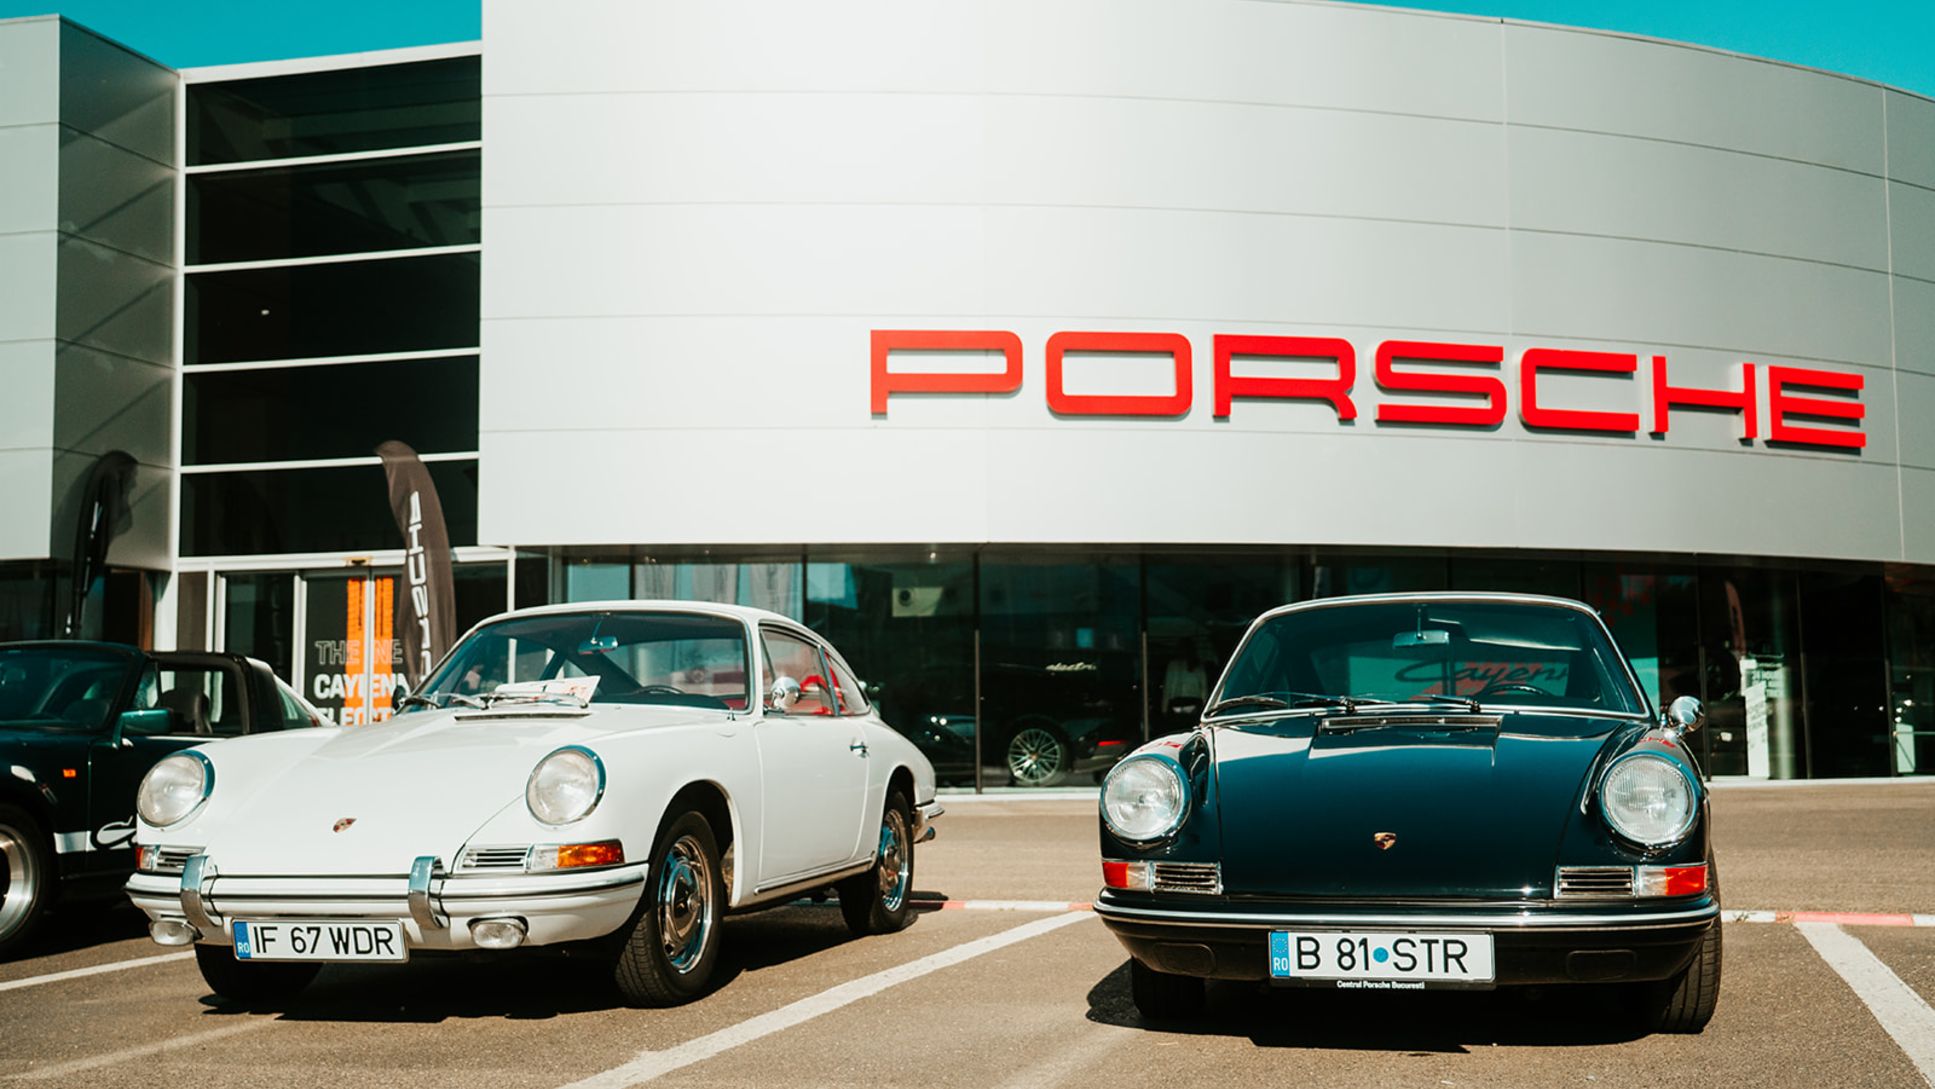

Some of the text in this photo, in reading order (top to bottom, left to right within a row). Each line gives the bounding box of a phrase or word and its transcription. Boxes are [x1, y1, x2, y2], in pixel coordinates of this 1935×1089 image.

[870, 330, 1867, 450] PORSCHE
[313, 638, 404, 665] THE NE
[237, 942, 250, 953] RO
[253, 926, 395, 955] IF 67 WDR
[1273, 957, 1289, 971] RO
[1296, 936, 1468, 974] B 81 STR
[1363, 980, 1391, 990] Porsche
